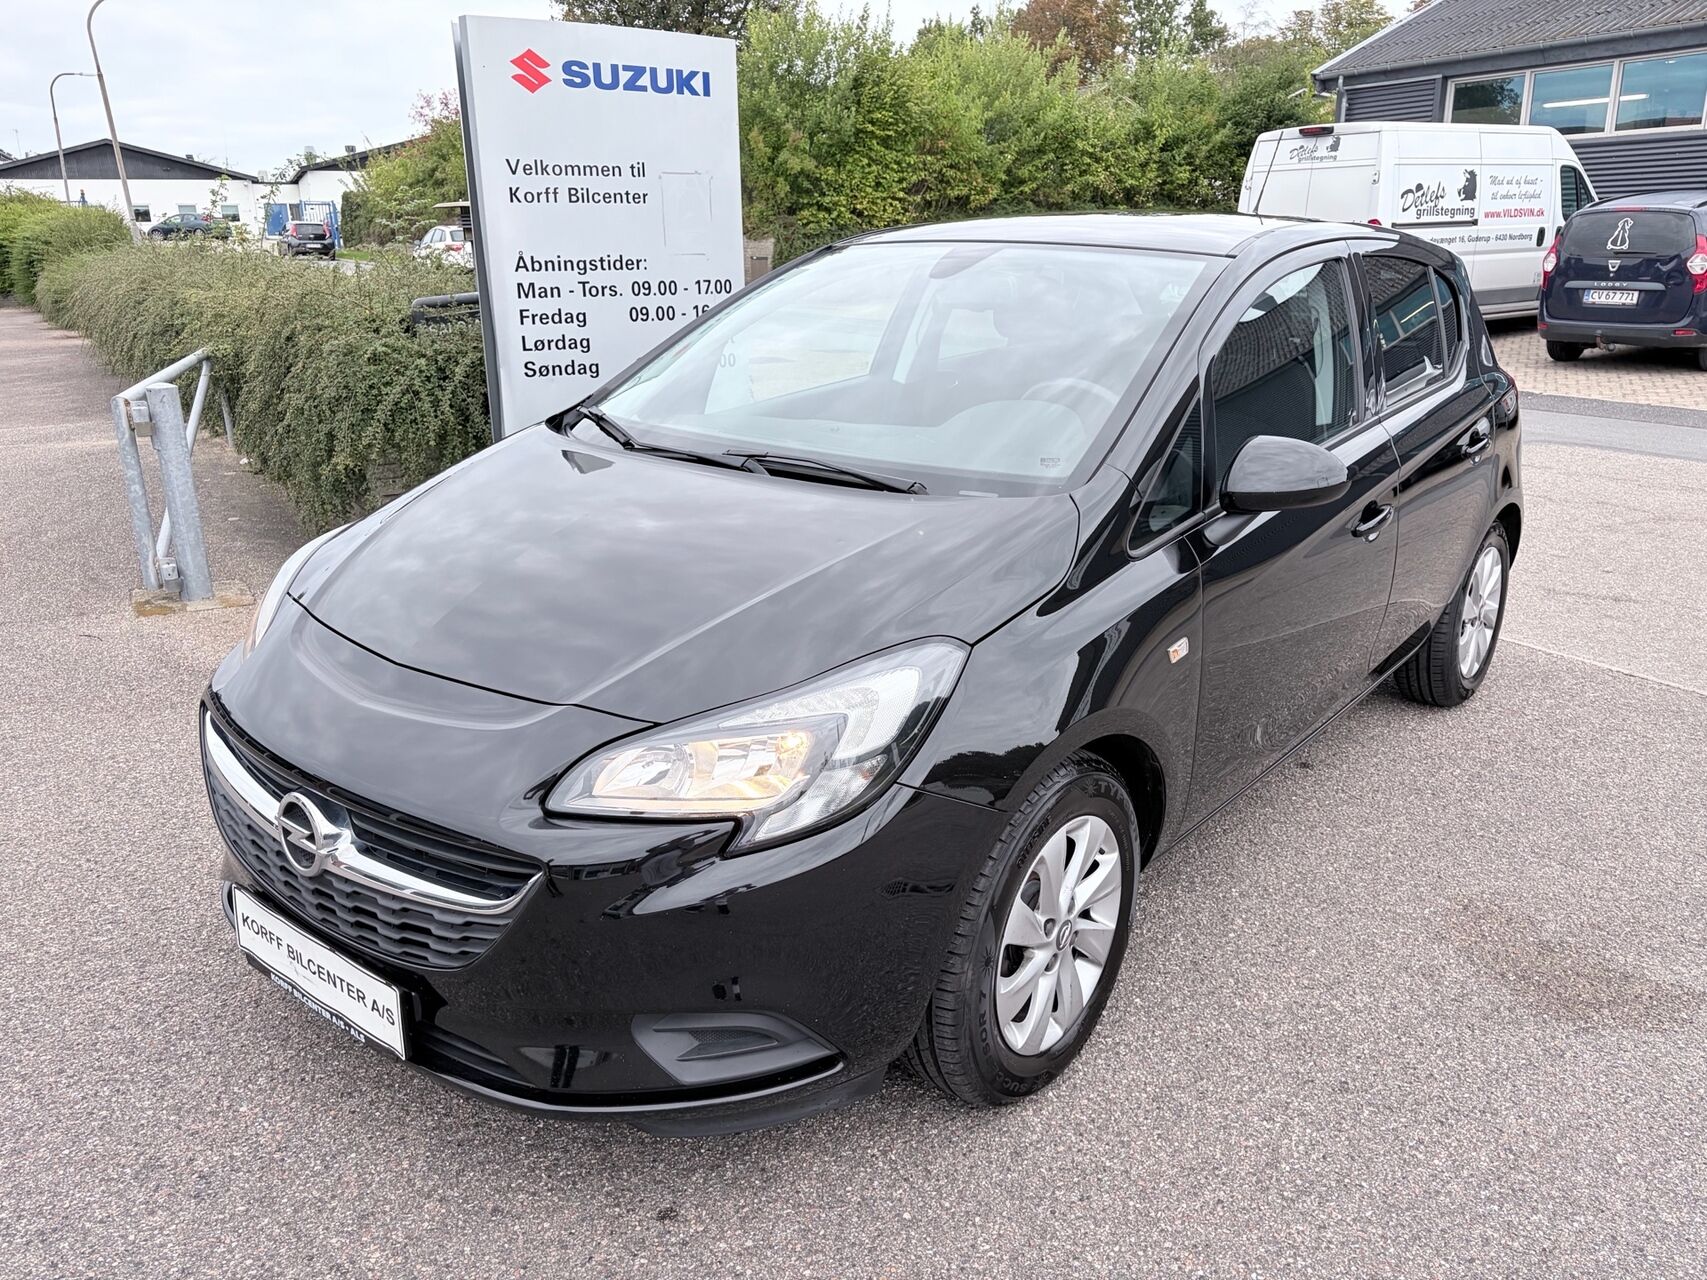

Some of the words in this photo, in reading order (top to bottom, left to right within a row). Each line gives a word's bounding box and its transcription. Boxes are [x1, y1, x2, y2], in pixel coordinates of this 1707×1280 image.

[561, 60, 711, 97] SUZUKI
[505, 158, 622, 178] Velkommen
[629, 162, 646, 178] til
[509, 187, 559, 204] Korff
[567, 188, 648, 205] Bilcenter
[1400, 181, 1446, 212] Detlefs
[1416, 205, 1475, 219] grillstegning
[1484, 207, 1545, 218] www.VILDSVIN.dk
[1468, 234, 1490, 244] Guderup
[1509, 233, 1533, 241] Nordborg
[515, 251, 648, 275] Åbningstider:
[517, 282, 561, 299] Man
[578, 281, 623, 298] Tors.
[631, 280, 678, 297] 09.00
[695, 279, 732, 295] 17.00
[1591, 291, 1604, 300] CV
[1605, 291, 1617, 300] 67
[1619, 292, 1635, 301] 771
[519, 308, 587, 327] Fredag
[629, 305, 675, 322] 09.00
[521, 335, 591, 353] Lørdag
[524, 360, 600, 379] Søndag
[241, 912, 283, 950] KORFF
[286, 943, 367, 1008] BILCENTER
[371, 1001, 396, 1027] A/S
